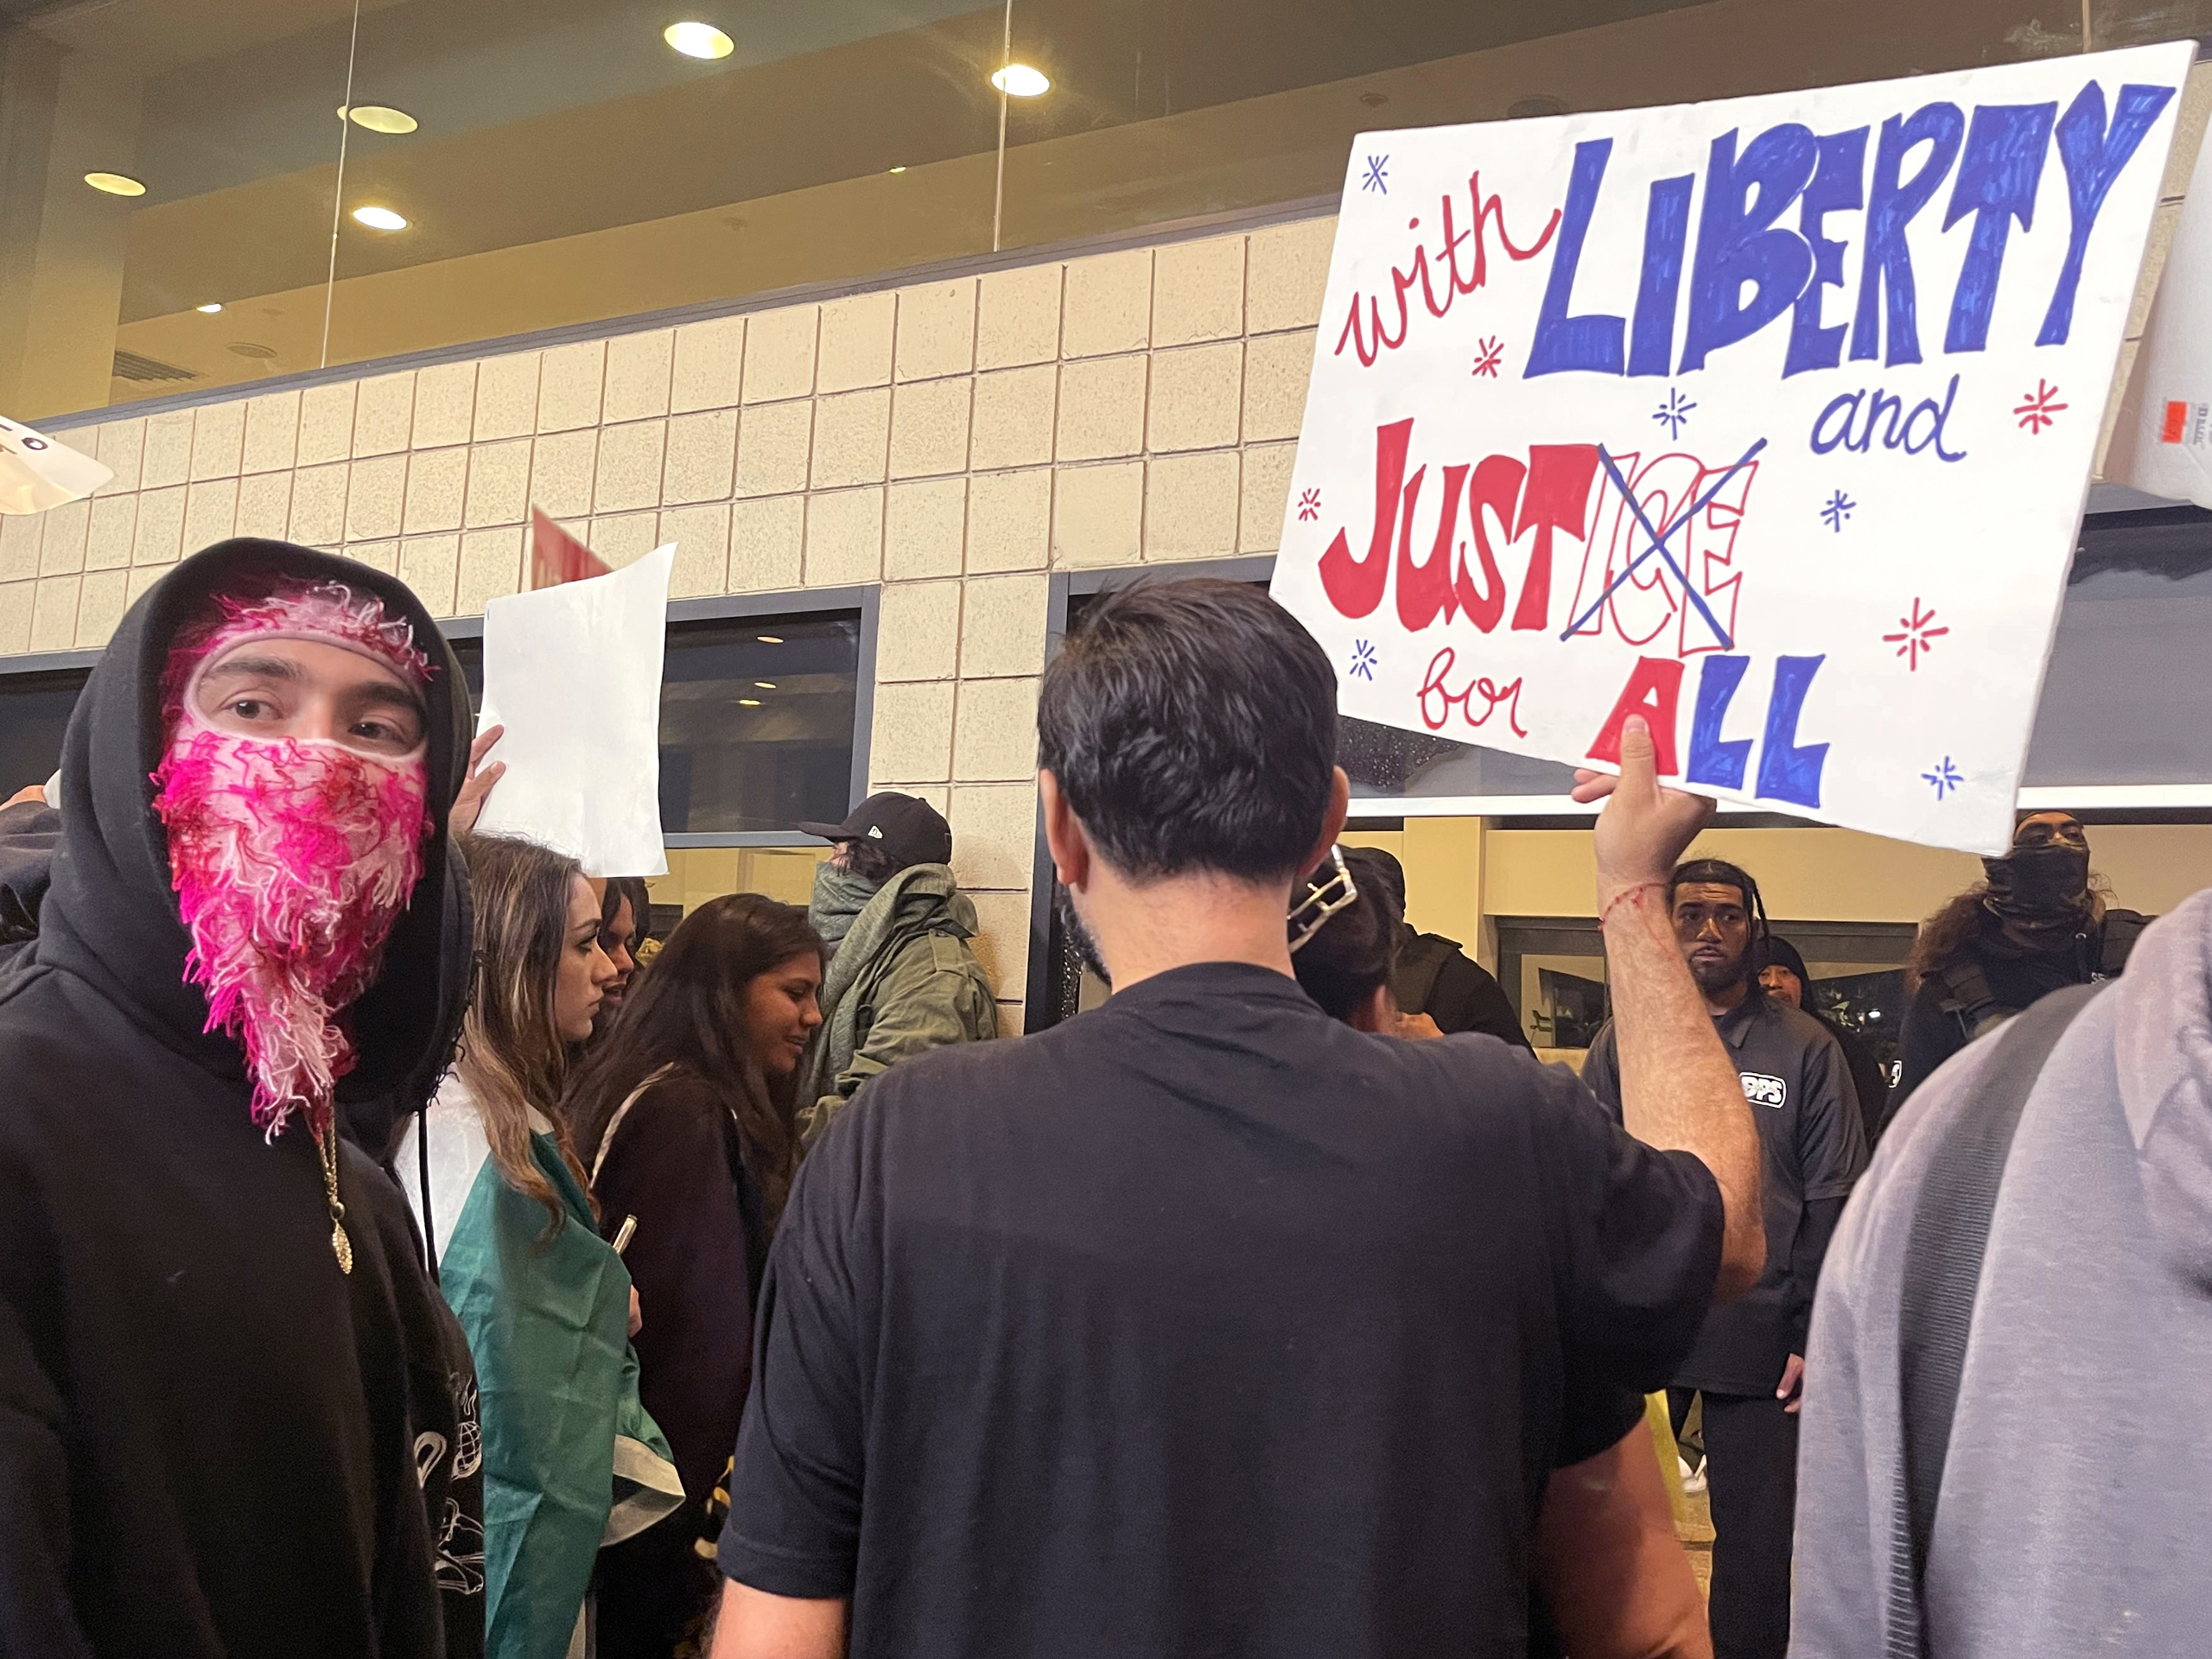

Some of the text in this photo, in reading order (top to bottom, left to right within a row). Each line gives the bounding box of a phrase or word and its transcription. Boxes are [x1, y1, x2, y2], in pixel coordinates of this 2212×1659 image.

[1335, 79, 2176, 378] with LIBERTY
[1810, 375, 1967, 462] and
[1417, 646, 1830, 810] for ALL
